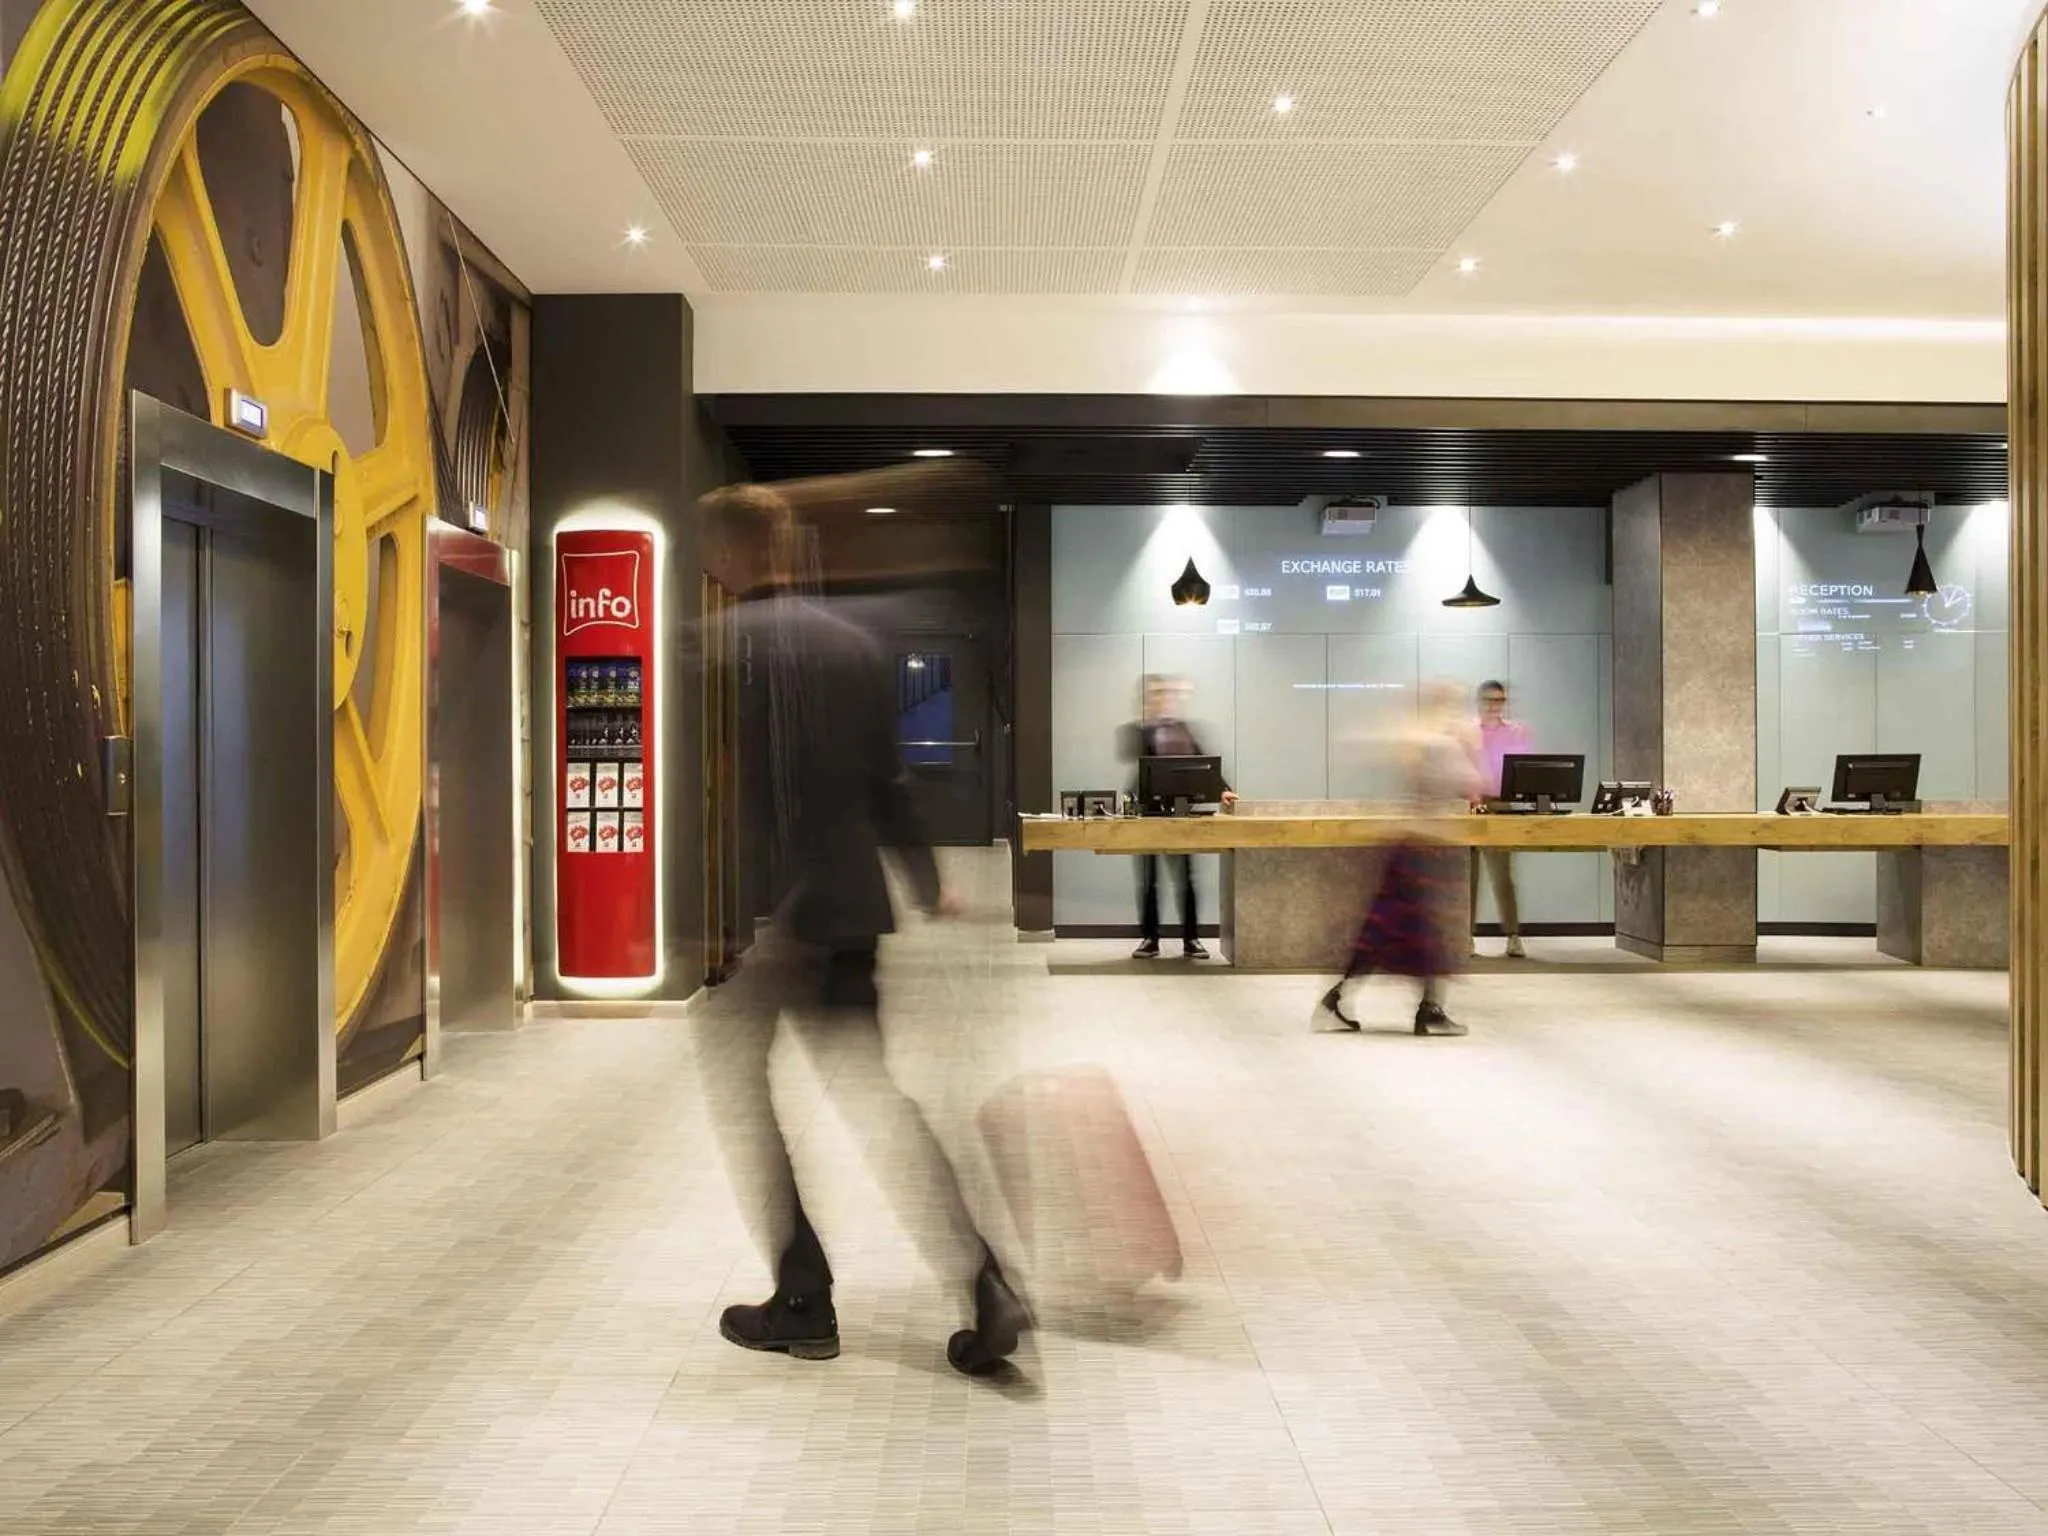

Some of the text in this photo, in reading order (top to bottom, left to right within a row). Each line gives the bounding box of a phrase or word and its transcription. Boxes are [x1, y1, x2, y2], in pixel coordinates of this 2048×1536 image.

[1281, 560, 1412, 574] EXCHANGE RATES
[1788, 584, 1873, 597] RECEPTION
[570, 587, 632, 618] info
